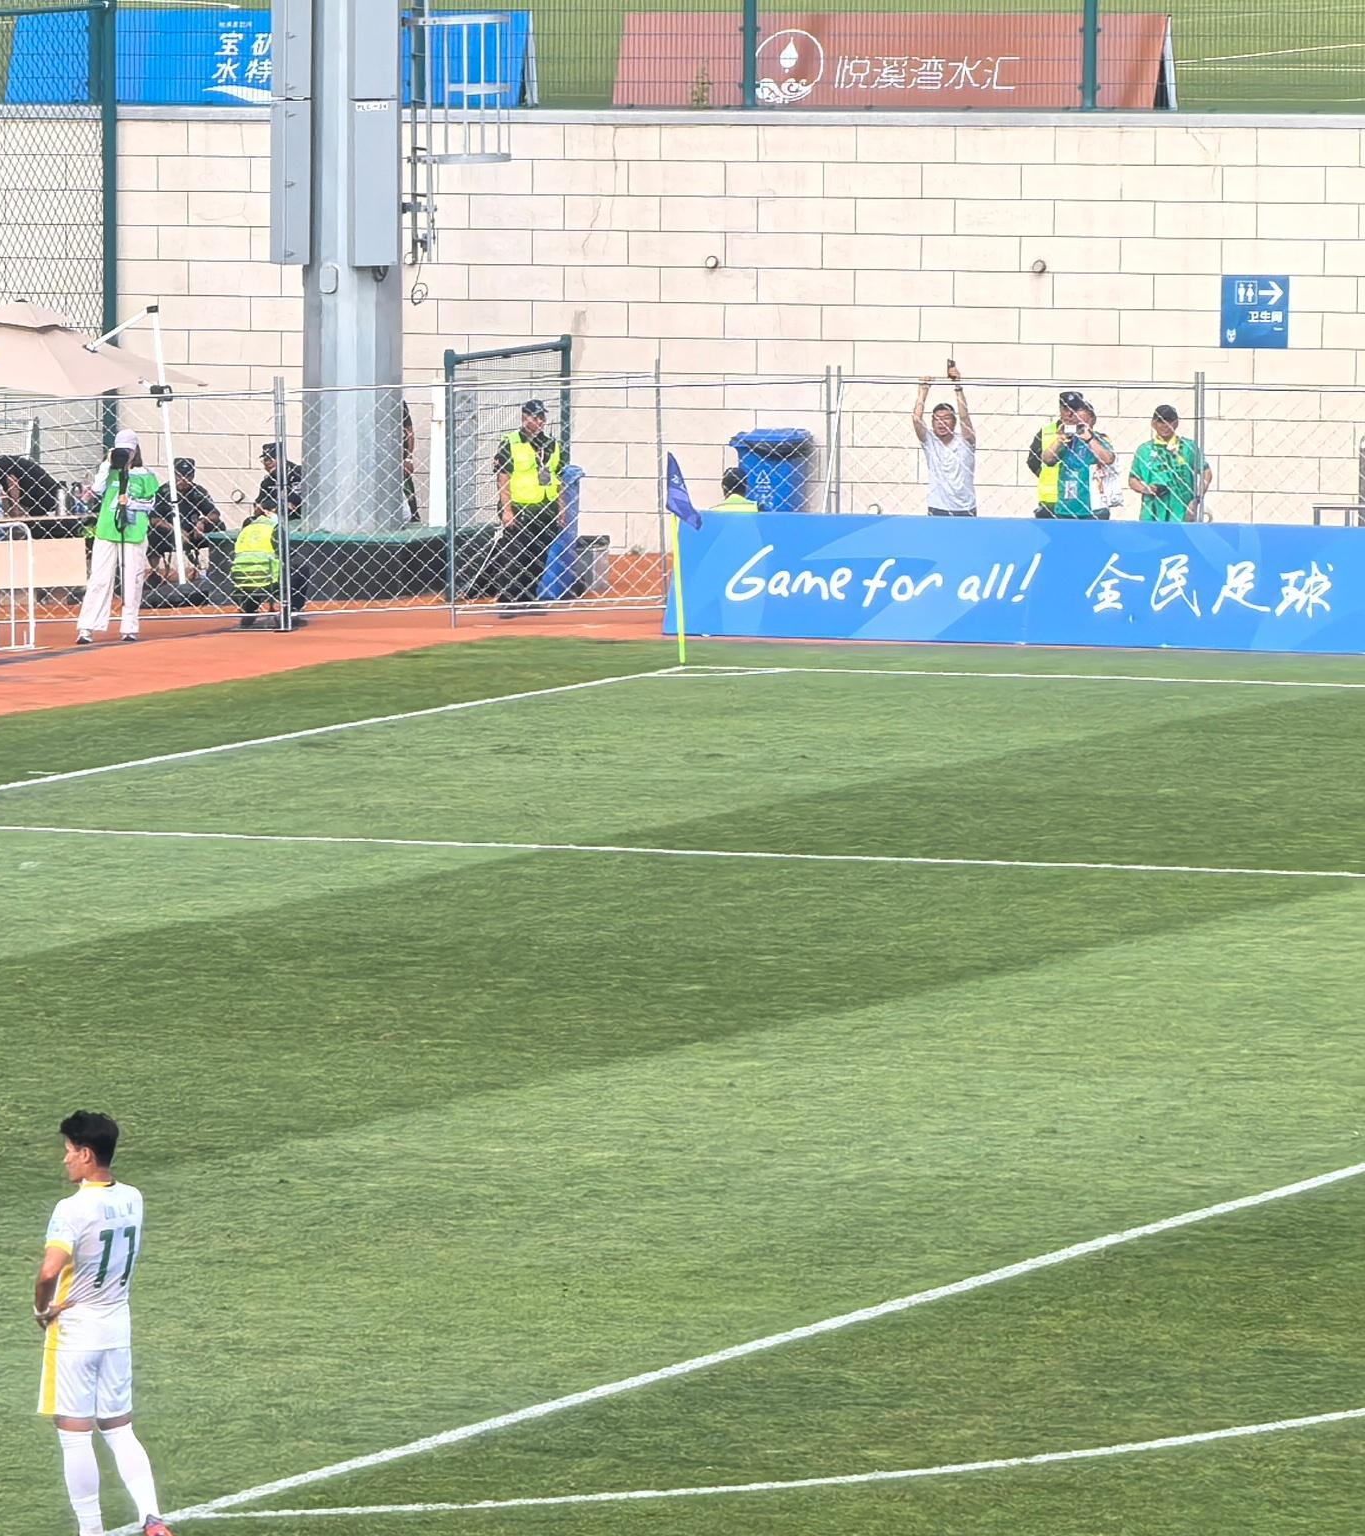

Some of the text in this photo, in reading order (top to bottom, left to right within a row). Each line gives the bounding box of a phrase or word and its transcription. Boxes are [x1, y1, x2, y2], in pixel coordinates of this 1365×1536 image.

[214, 30, 273, 56] 宝矿
[835, 56, 1020, 90] 悦溪湾水汇
[1247, 310, 1283, 323] 卫生间
[725, 545, 1041, 607] Game for all!
[1085, 553, 1333, 618] 全民足球
[94, 1226, 137, 1288] 11
